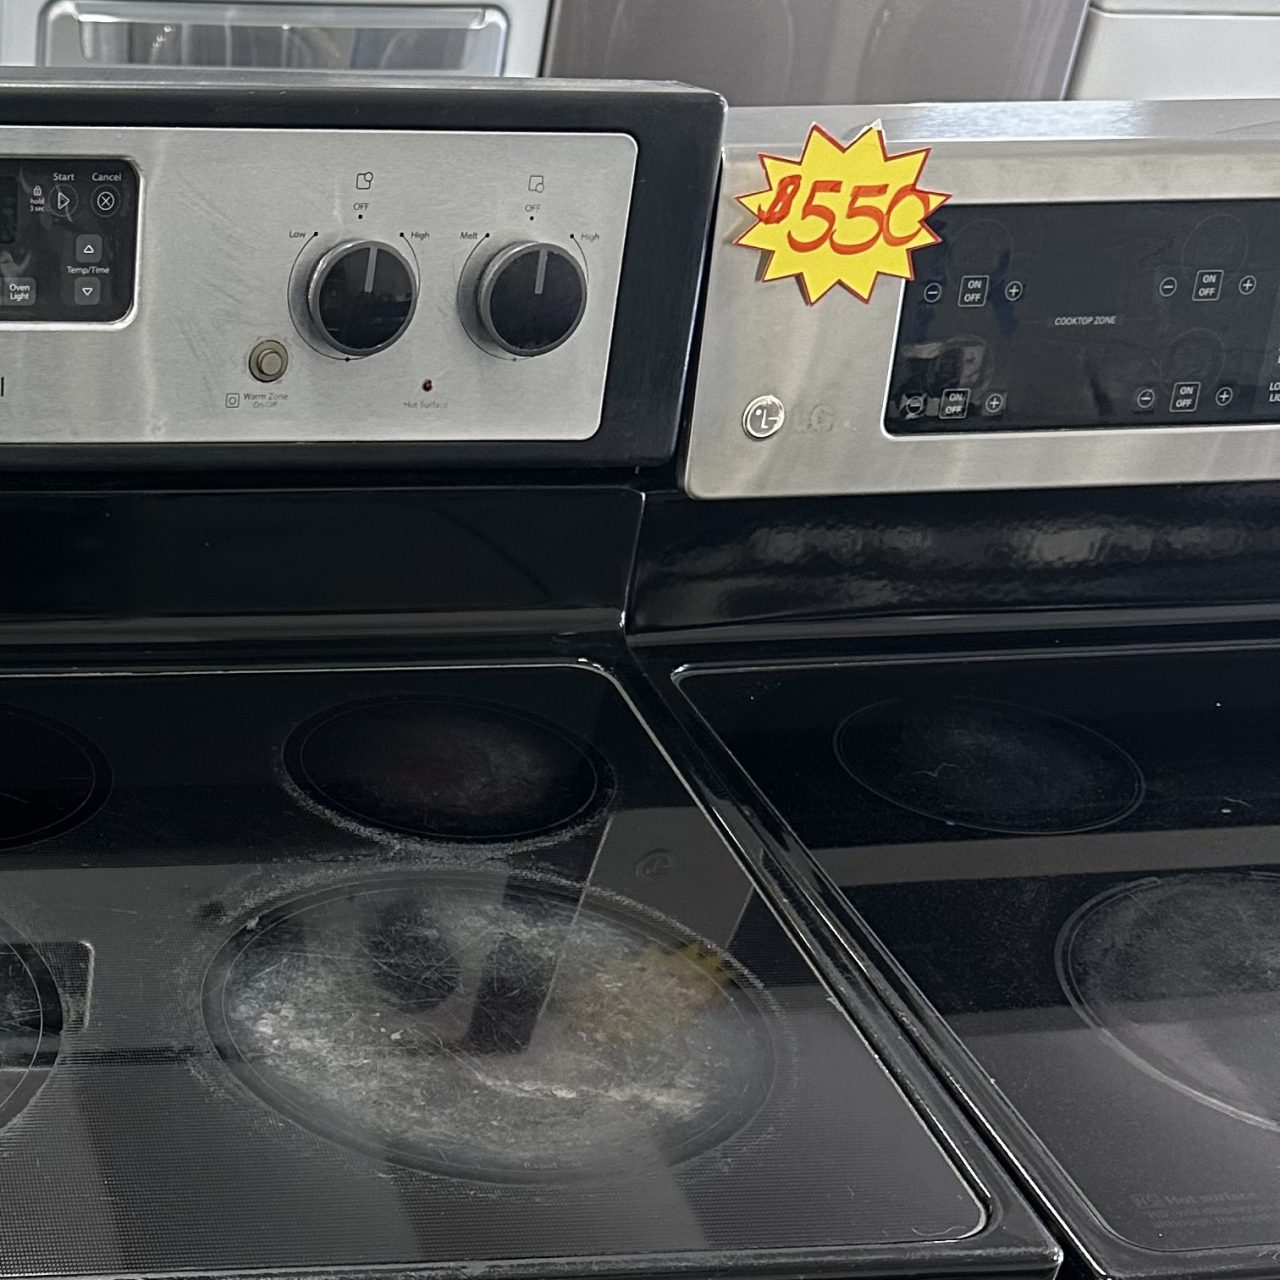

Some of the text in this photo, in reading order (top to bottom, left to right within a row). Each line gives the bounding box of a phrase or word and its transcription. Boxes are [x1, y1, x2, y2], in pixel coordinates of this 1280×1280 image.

[52, 172, 75, 181] Start
[91, 172, 122, 181] Cancel
[29, 197, 45, 205] hold
[352, 202, 370, 211] OFF
[523, 204, 542, 213] OFF
[757, 174, 930, 255] $550
[289, 231, 306, 239] Low
[410, 231, 430, 241] High
[460, 231, 478, 240] Melt
[580, 233, 600, 243] High
[66, 265, 110, 275] Temp/Time
[1203, 274, 1218, 284] ON
[9, 283, 30, 292] Oven
[967, 280, 982, 289] ON
[10, 291, 30, 302] Light
[1198, 287, 1217, 297] OFF
[963, 293, 982, 303] OFF
[1054, 315, 1117, 326] COOKTOP ZONE
[1179, 386, 1194, 395] ON
[243, 392, 267, 401] Warm
[948, 393, 964, 402] ON
[1175, 398, 1193, 408] OFF
[944, 405, 963, 415] OFF
